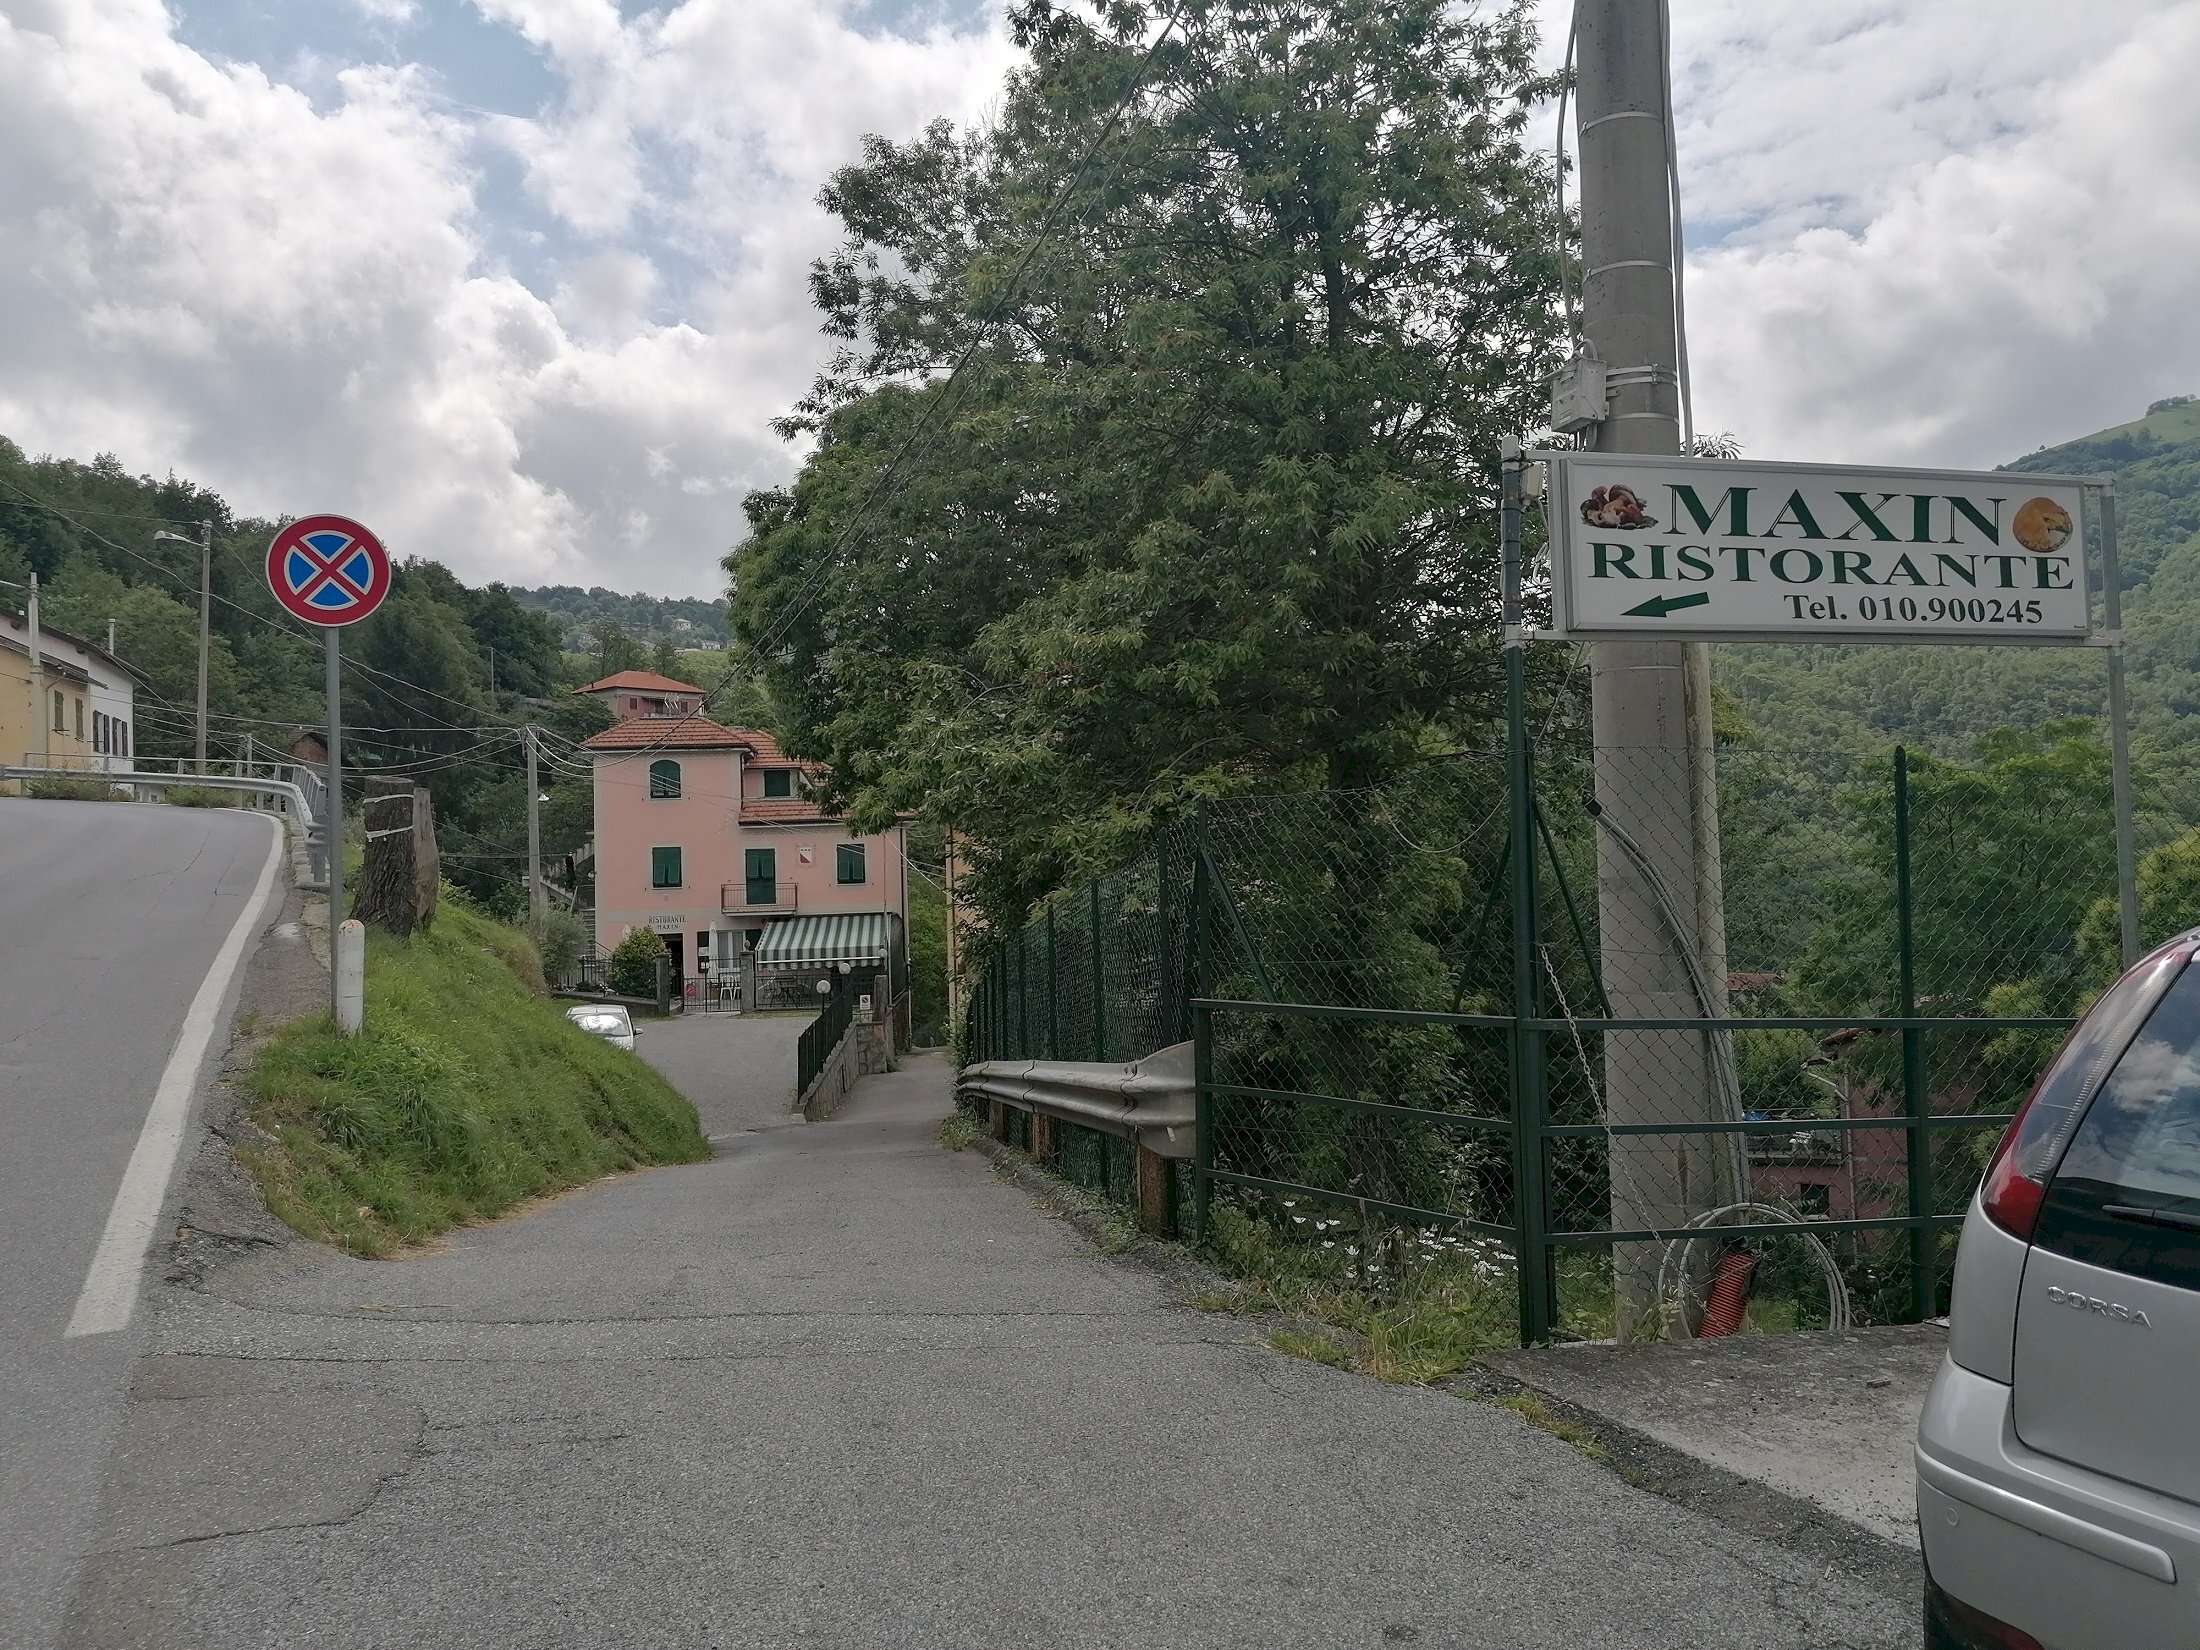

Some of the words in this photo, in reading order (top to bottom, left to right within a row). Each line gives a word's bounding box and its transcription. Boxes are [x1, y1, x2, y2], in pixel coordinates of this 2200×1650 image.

[1662, 484, 2007, 546] MAXIN
[1586, 542, 2074, 589] RISTORANTE
[1783, 594, 1848, 620] Tel.
[1858, 596, 2043, 624] 010.900245
[2047, 1286, 2152, 1329] CORSA
